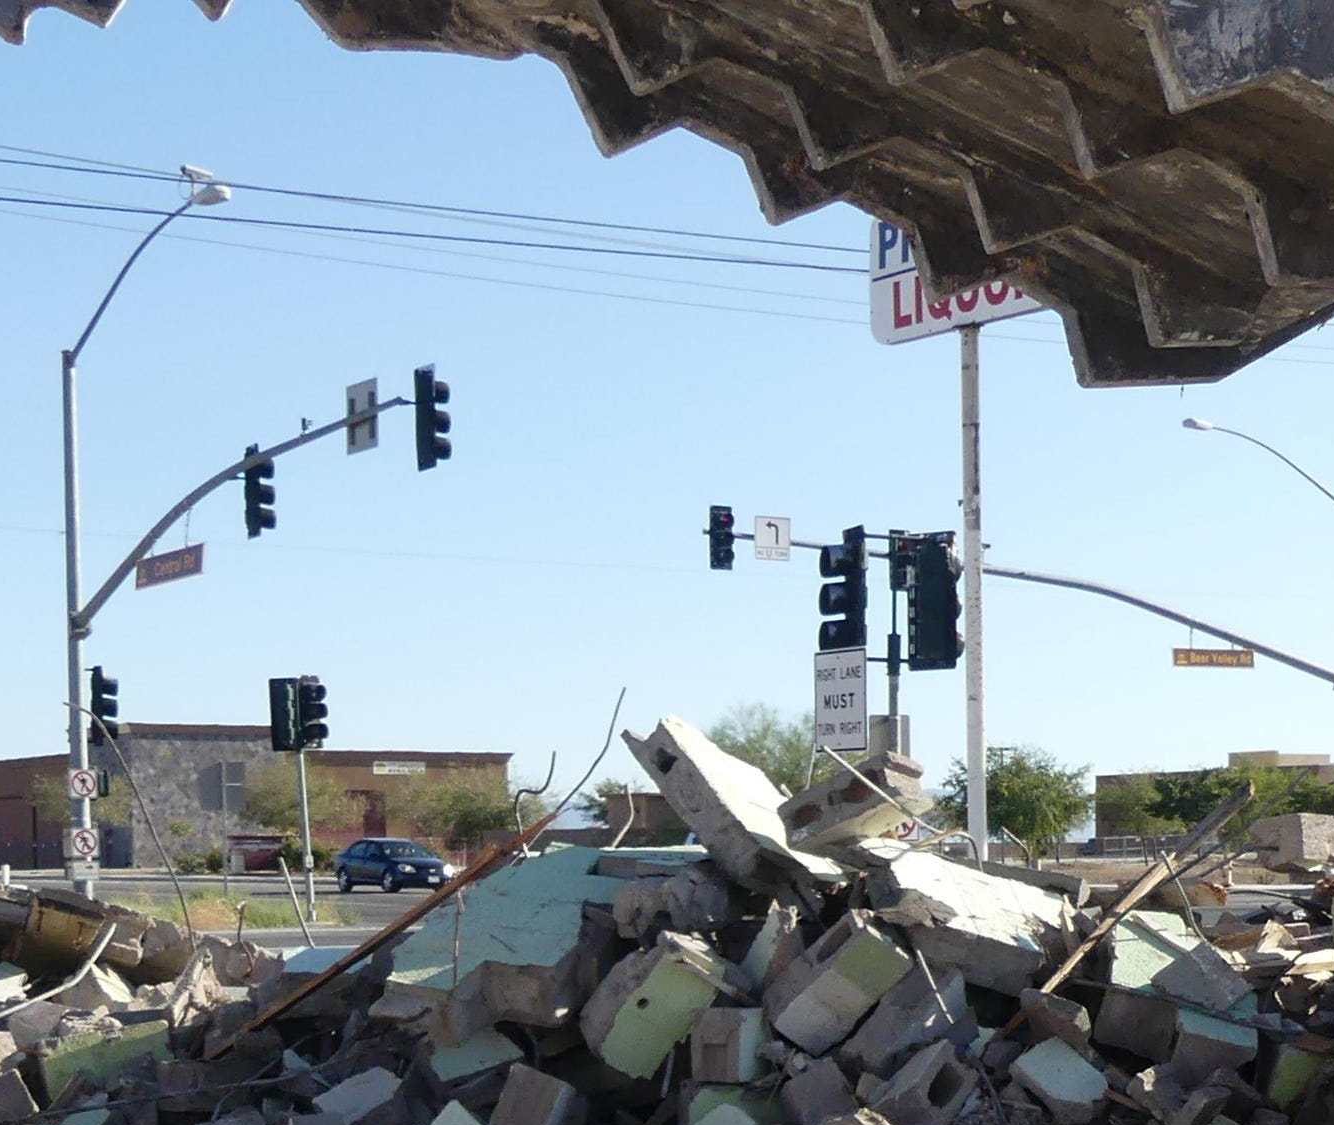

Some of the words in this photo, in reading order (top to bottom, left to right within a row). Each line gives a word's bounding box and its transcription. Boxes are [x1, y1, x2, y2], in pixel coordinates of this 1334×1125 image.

[892, 276, 1023, 329] LIQUO
[816, 667, 836, 681] RIGHT
[839, 665, 862, 680] LANE
[823, 692, 855, 710] MUST
[817, 723, 836, 737] TURN
[839, 721, 862, 735] RIGHT
